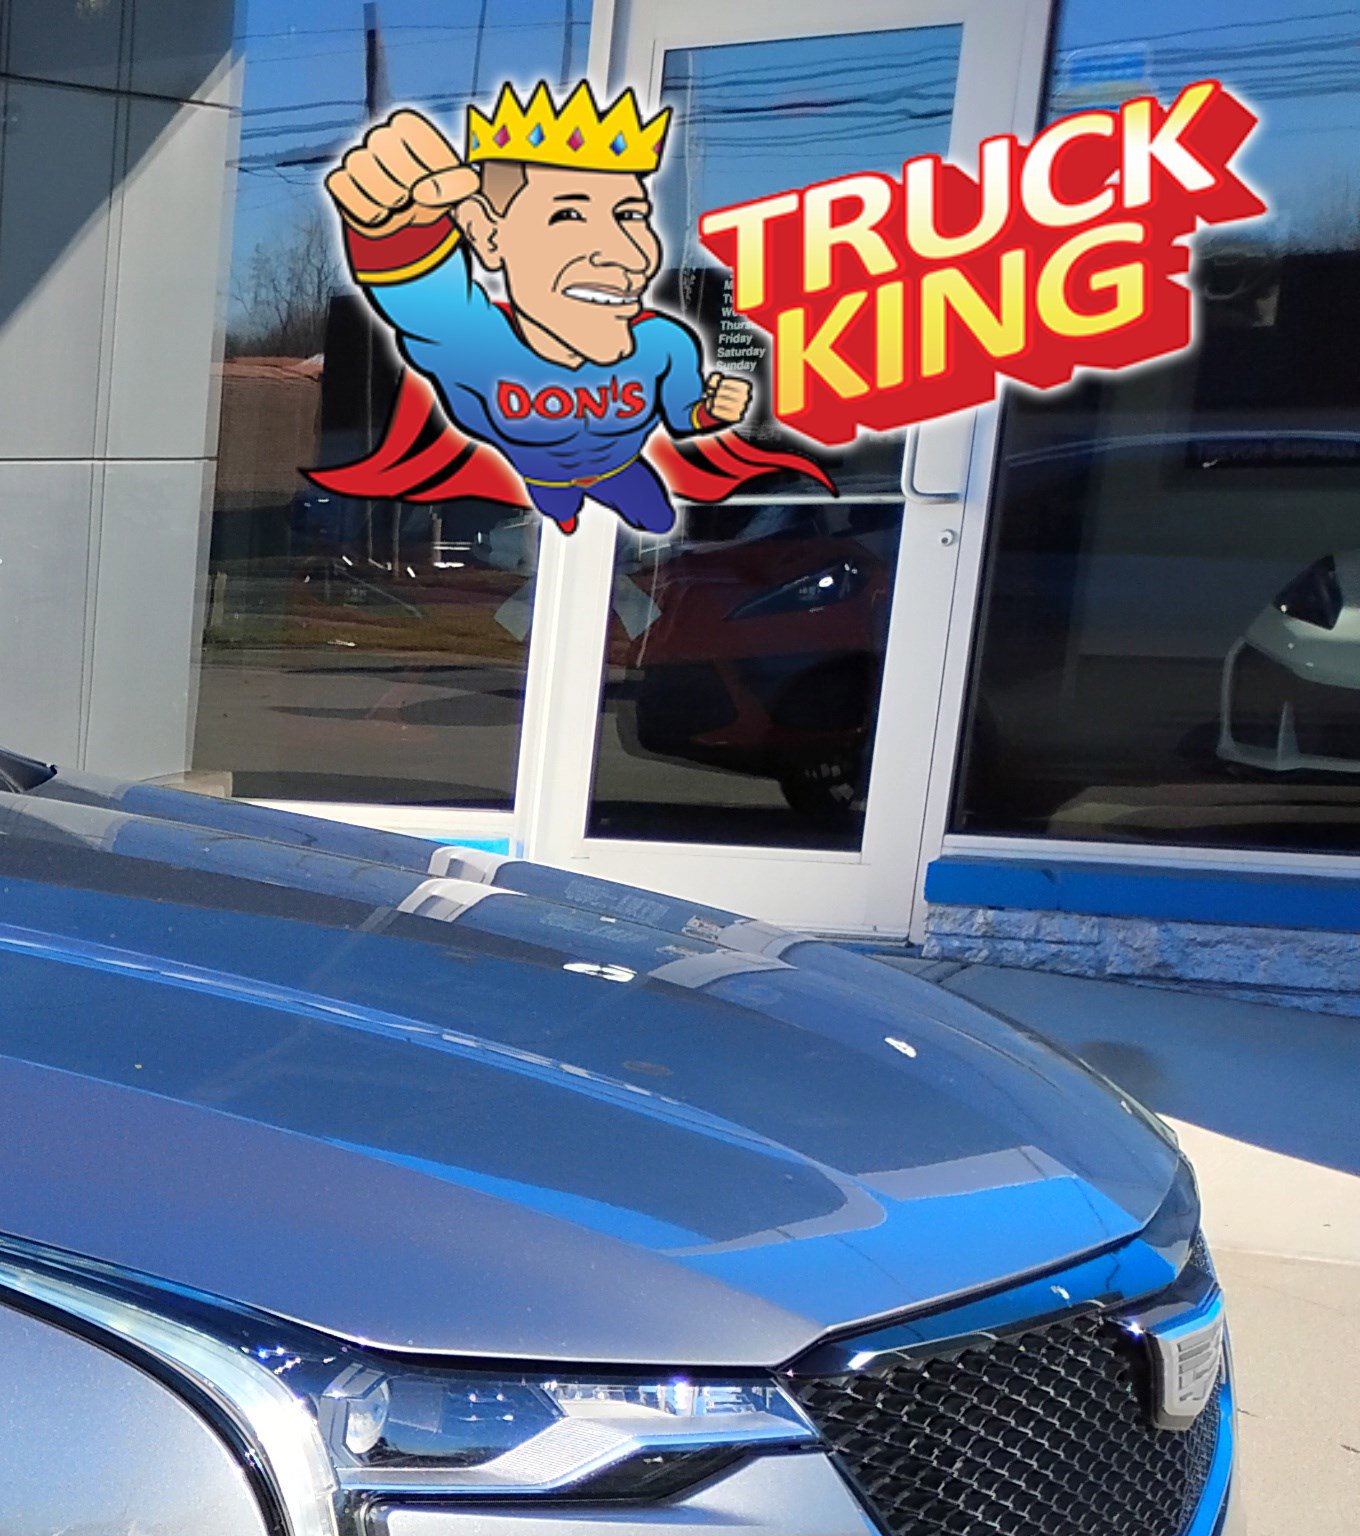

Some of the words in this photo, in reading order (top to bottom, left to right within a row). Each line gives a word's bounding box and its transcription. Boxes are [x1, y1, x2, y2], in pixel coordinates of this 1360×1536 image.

[718, 333, 753, 345] Friday
[717, 347, 766, 359] Saturday
[715, 360, 758, 372] Sunday
